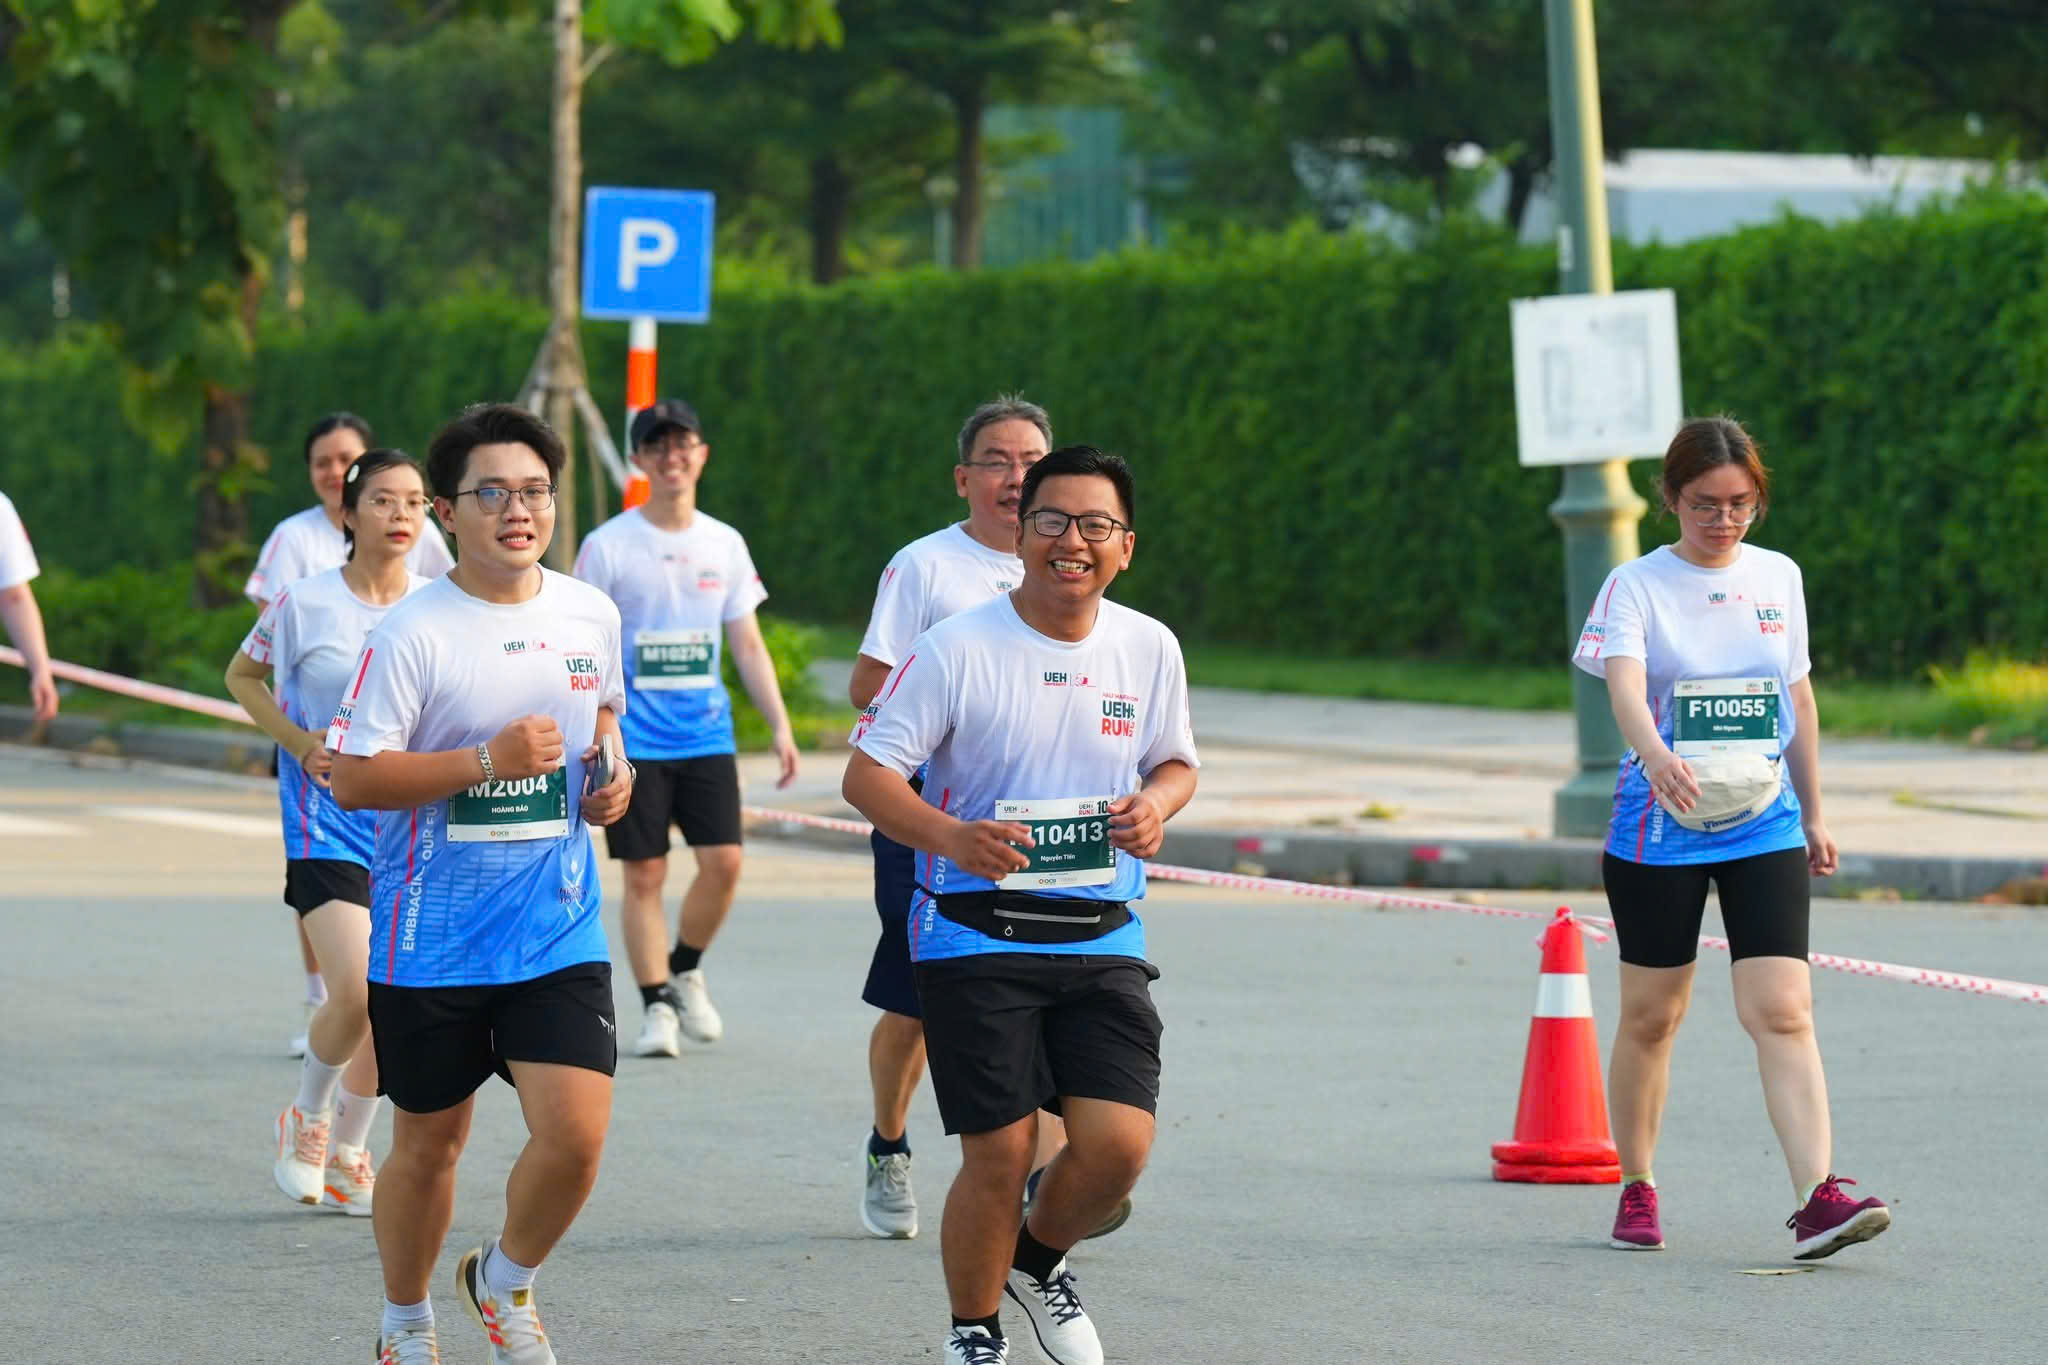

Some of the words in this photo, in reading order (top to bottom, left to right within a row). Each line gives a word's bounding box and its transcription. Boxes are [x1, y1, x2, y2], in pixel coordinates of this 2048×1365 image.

[618, 217, 678, 292] P
[1708, 592, 1726, 602] UEH
[1760, 621, 1784, 634] RUN
[504, 641, 525, 652] UEH
[566, 658, 594, 673] UEH
[570, 674, 595, 691] RUN
[1044, 671, 1067, 683] UEH
[1763, 680, 1773, 692] 10
[1102, 700, 1131, 719] UEH
[1689, 698, 1766, 718] F10055
[1101, 718, 1130, 737] RUN
[467, 773, 549, 798] M2004
[1096, 800, 1109, 814] 10
[1009, 821, 1103, 847] 10413
[422, 829, 435, 861] OUR
